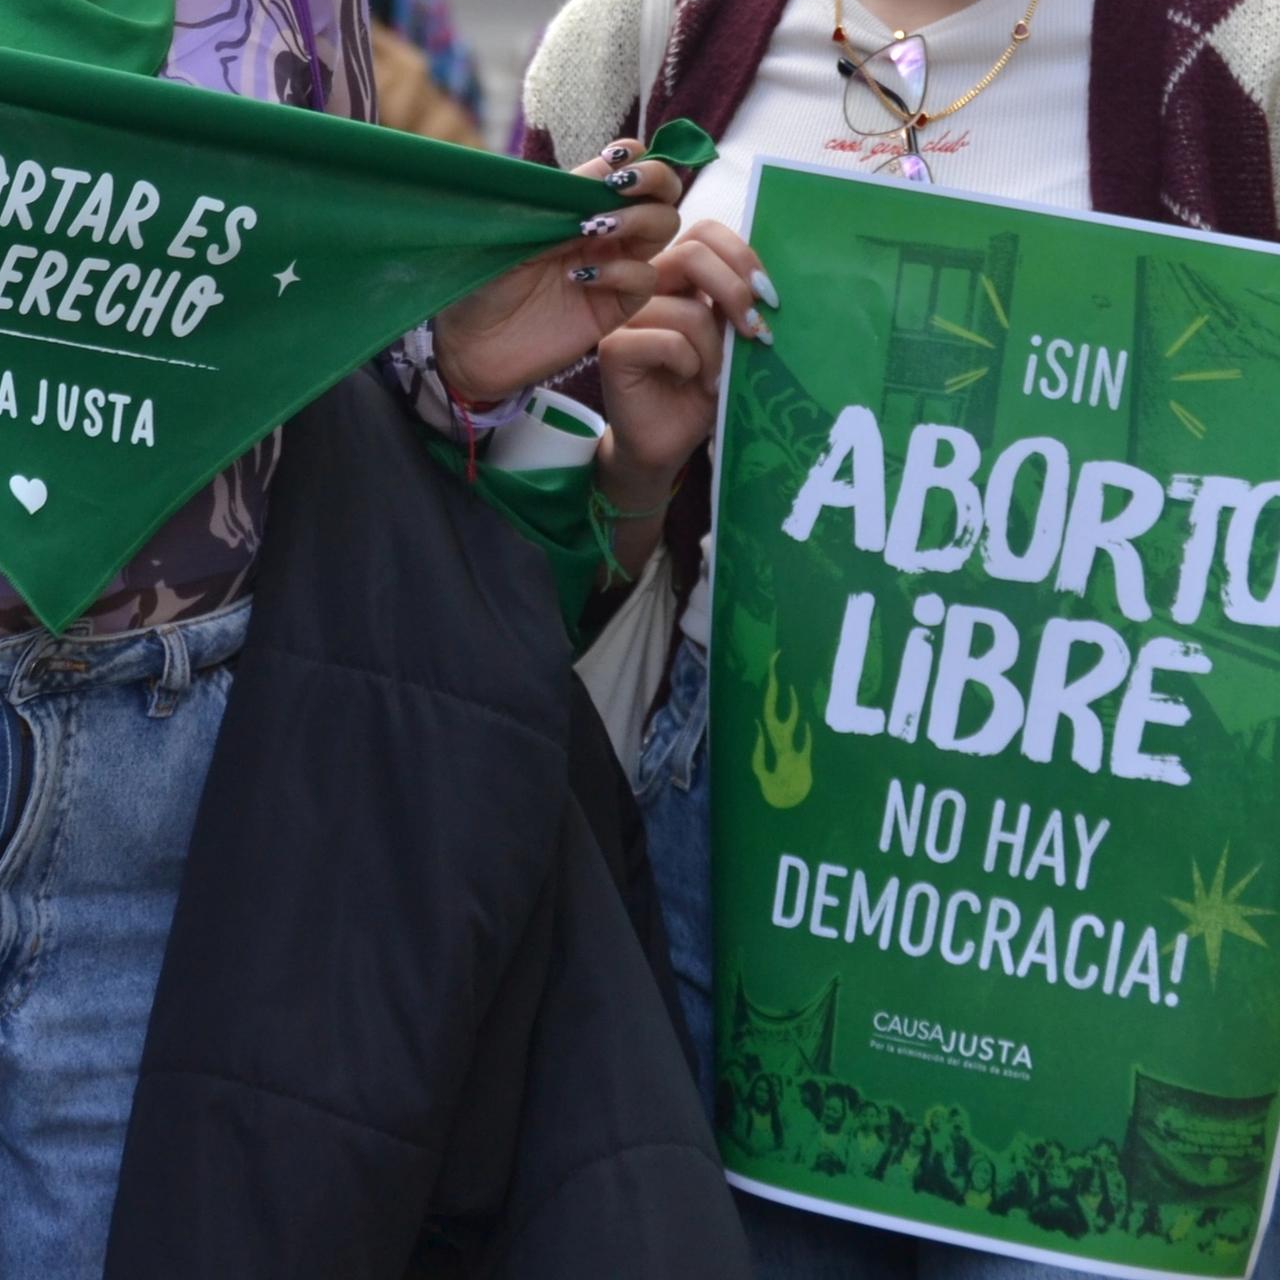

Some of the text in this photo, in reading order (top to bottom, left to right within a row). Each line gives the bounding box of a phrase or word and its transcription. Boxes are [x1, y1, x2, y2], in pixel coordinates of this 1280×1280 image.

[166, 195, 258, 266] ES
[30, 378, 155, 448] JUSTA
[1022, 334, 1129, 411] ¡SIN
[781, 405, 1280, 627] ABORTO
[878, 778, 1111, 891] NO HAY
[771, 854, 1189, 1008] DEMOCRACIA!
